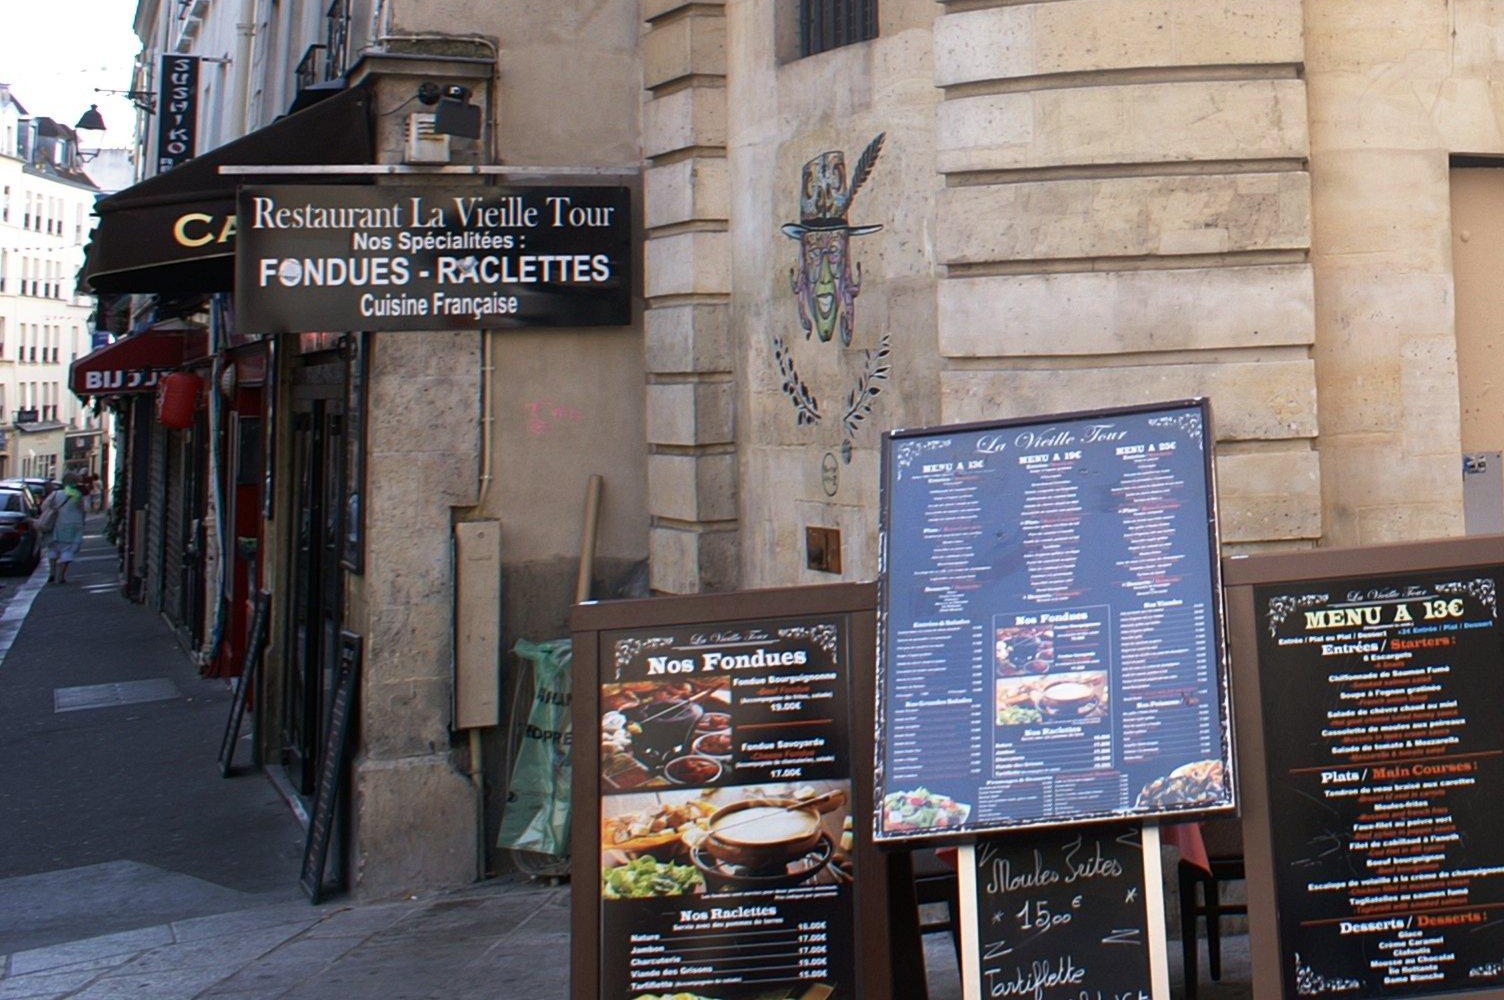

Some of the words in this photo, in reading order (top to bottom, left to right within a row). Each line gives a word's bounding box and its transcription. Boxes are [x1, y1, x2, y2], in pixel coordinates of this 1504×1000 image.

[252, 197, 402, 229] Restaurant
[410, 197, 446, 228] La
[453, 197, 538, 227] Vieille
[545, 196, 615, 227] Tour
[353, 231, 393, 250] Nos
[398, 231, 514, 254] Spécialitées
[260, 256, 410, 287] FONDUES
[437, 255, 610, 284] RACLETTES
[361, 293, 428, 317] Cuisine
[433, 291, 518, 320] Française
[975, 436, 1007, 454] La
[1014, 428, 1075, 449] Vieille
[1080, 423, 1128, 444] Tour
[1304, 606, 1383, 630] MENU
[1393, 604, 1413, 623] A
[1423, 599, 1465, 620] 13€
[1321, 642, 1379, 656] Entrées
[1390, 637, 1449, 651] Starters
[647, 656, 695, 676] Nos
[702, 649, 807, 672] Fondues
[733, 676, 766, 687] Fondue
[768, 671, 837, 685] Bourguignonne
[741, 742, 775, 752] Fondue
[777, 738, 825, 750] Savoyarde
[1321, 770, 1360, 784] Plats
[1372, 766, 1411, 780] Main
[1411, 762, 1472, 776] Courses
[987, 849, 1060, 893] Moules
[680, 909, 708, 922] Nos
[710, 905, 777, 920] Raclettes
[1339, 919, 1405, 935] Desserts
[1417, 911, 1482, 928] Desserts
[984, 955, 1086, 1000] Tartiflette
